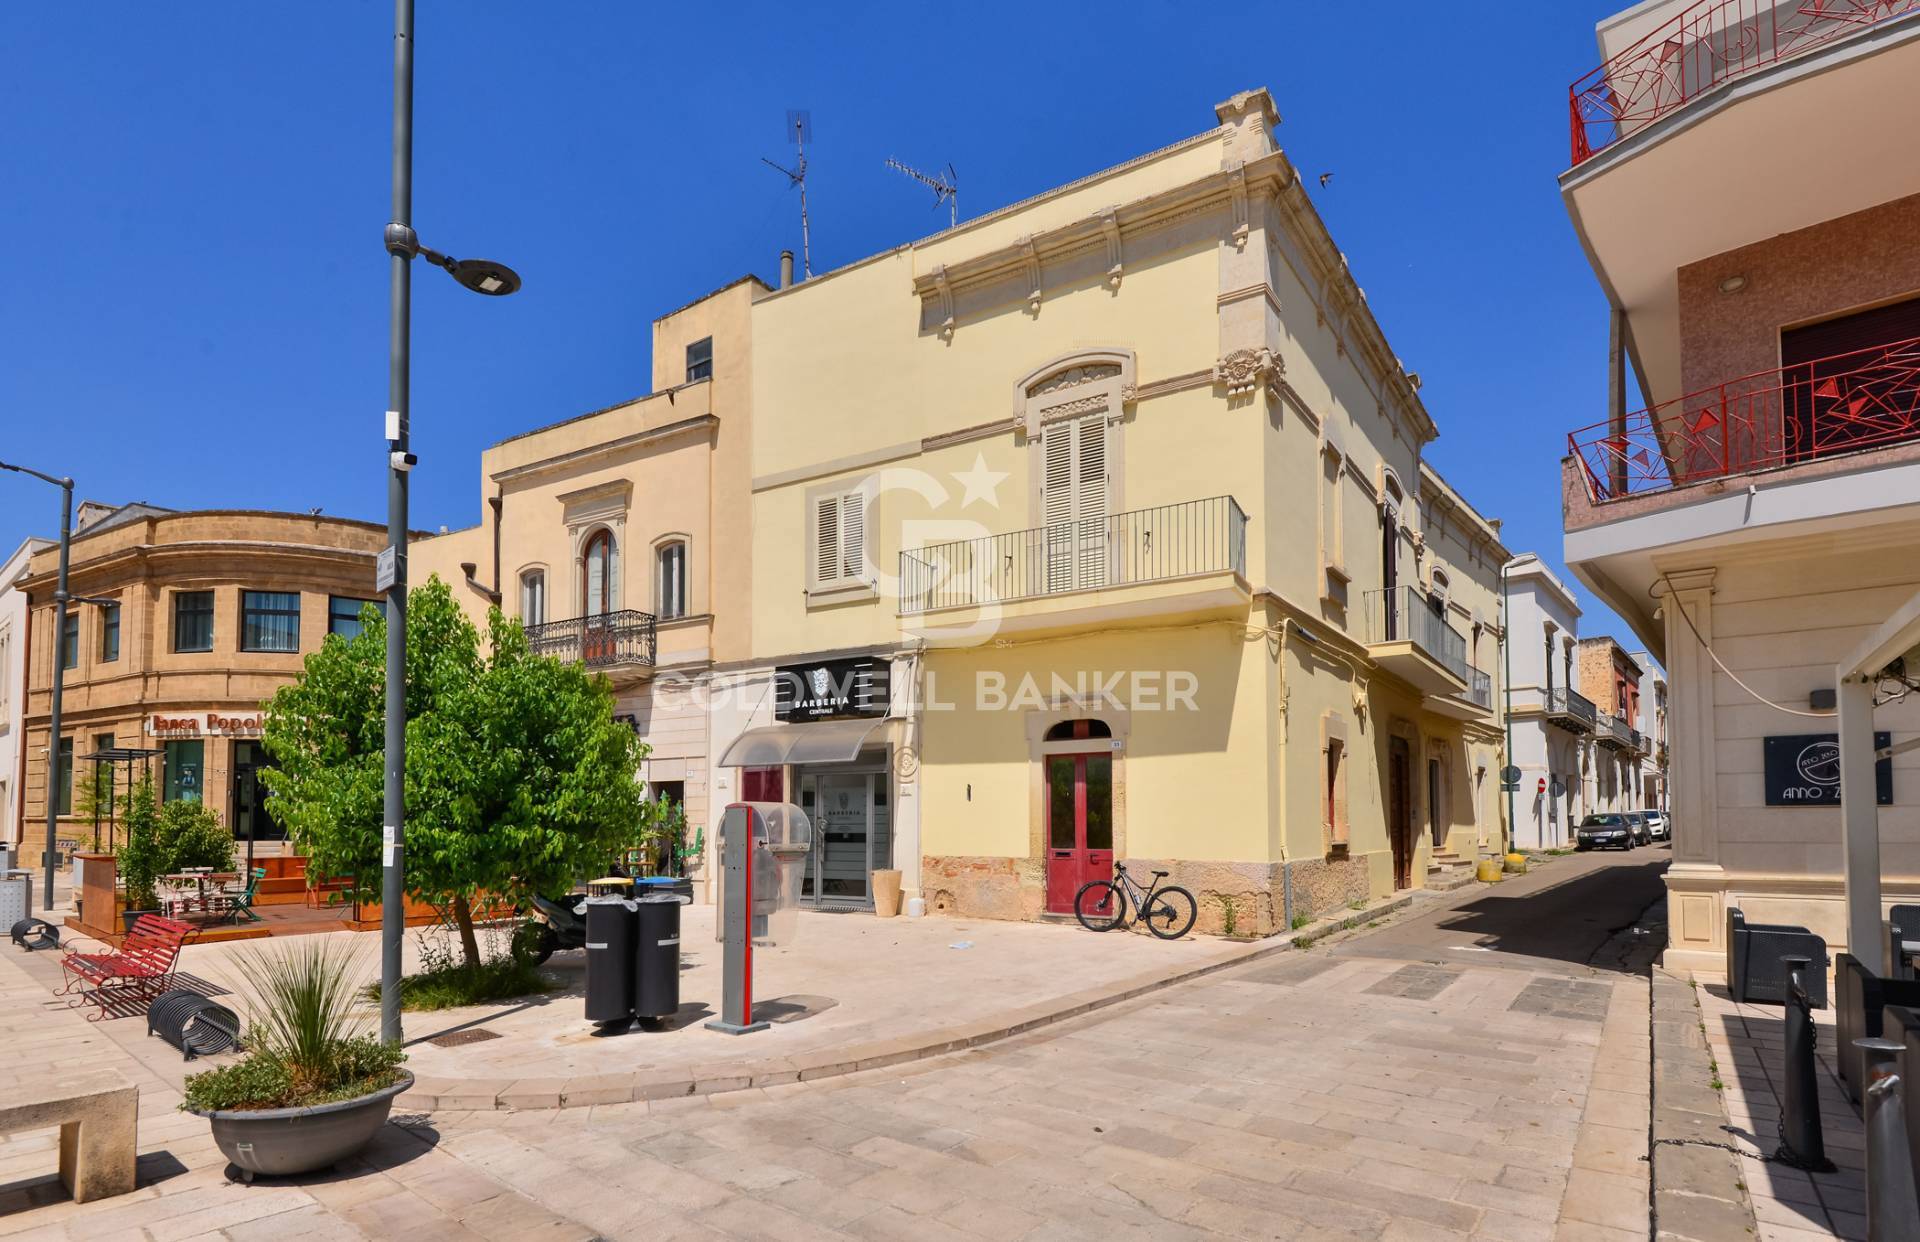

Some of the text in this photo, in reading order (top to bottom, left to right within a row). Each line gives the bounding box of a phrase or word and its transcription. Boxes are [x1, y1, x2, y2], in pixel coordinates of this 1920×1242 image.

[795, 697, 849, 708] BARBERIA
[153, 714, 263, 731] Banca Popol
[1783, 787, 1822, 798] ANNO
